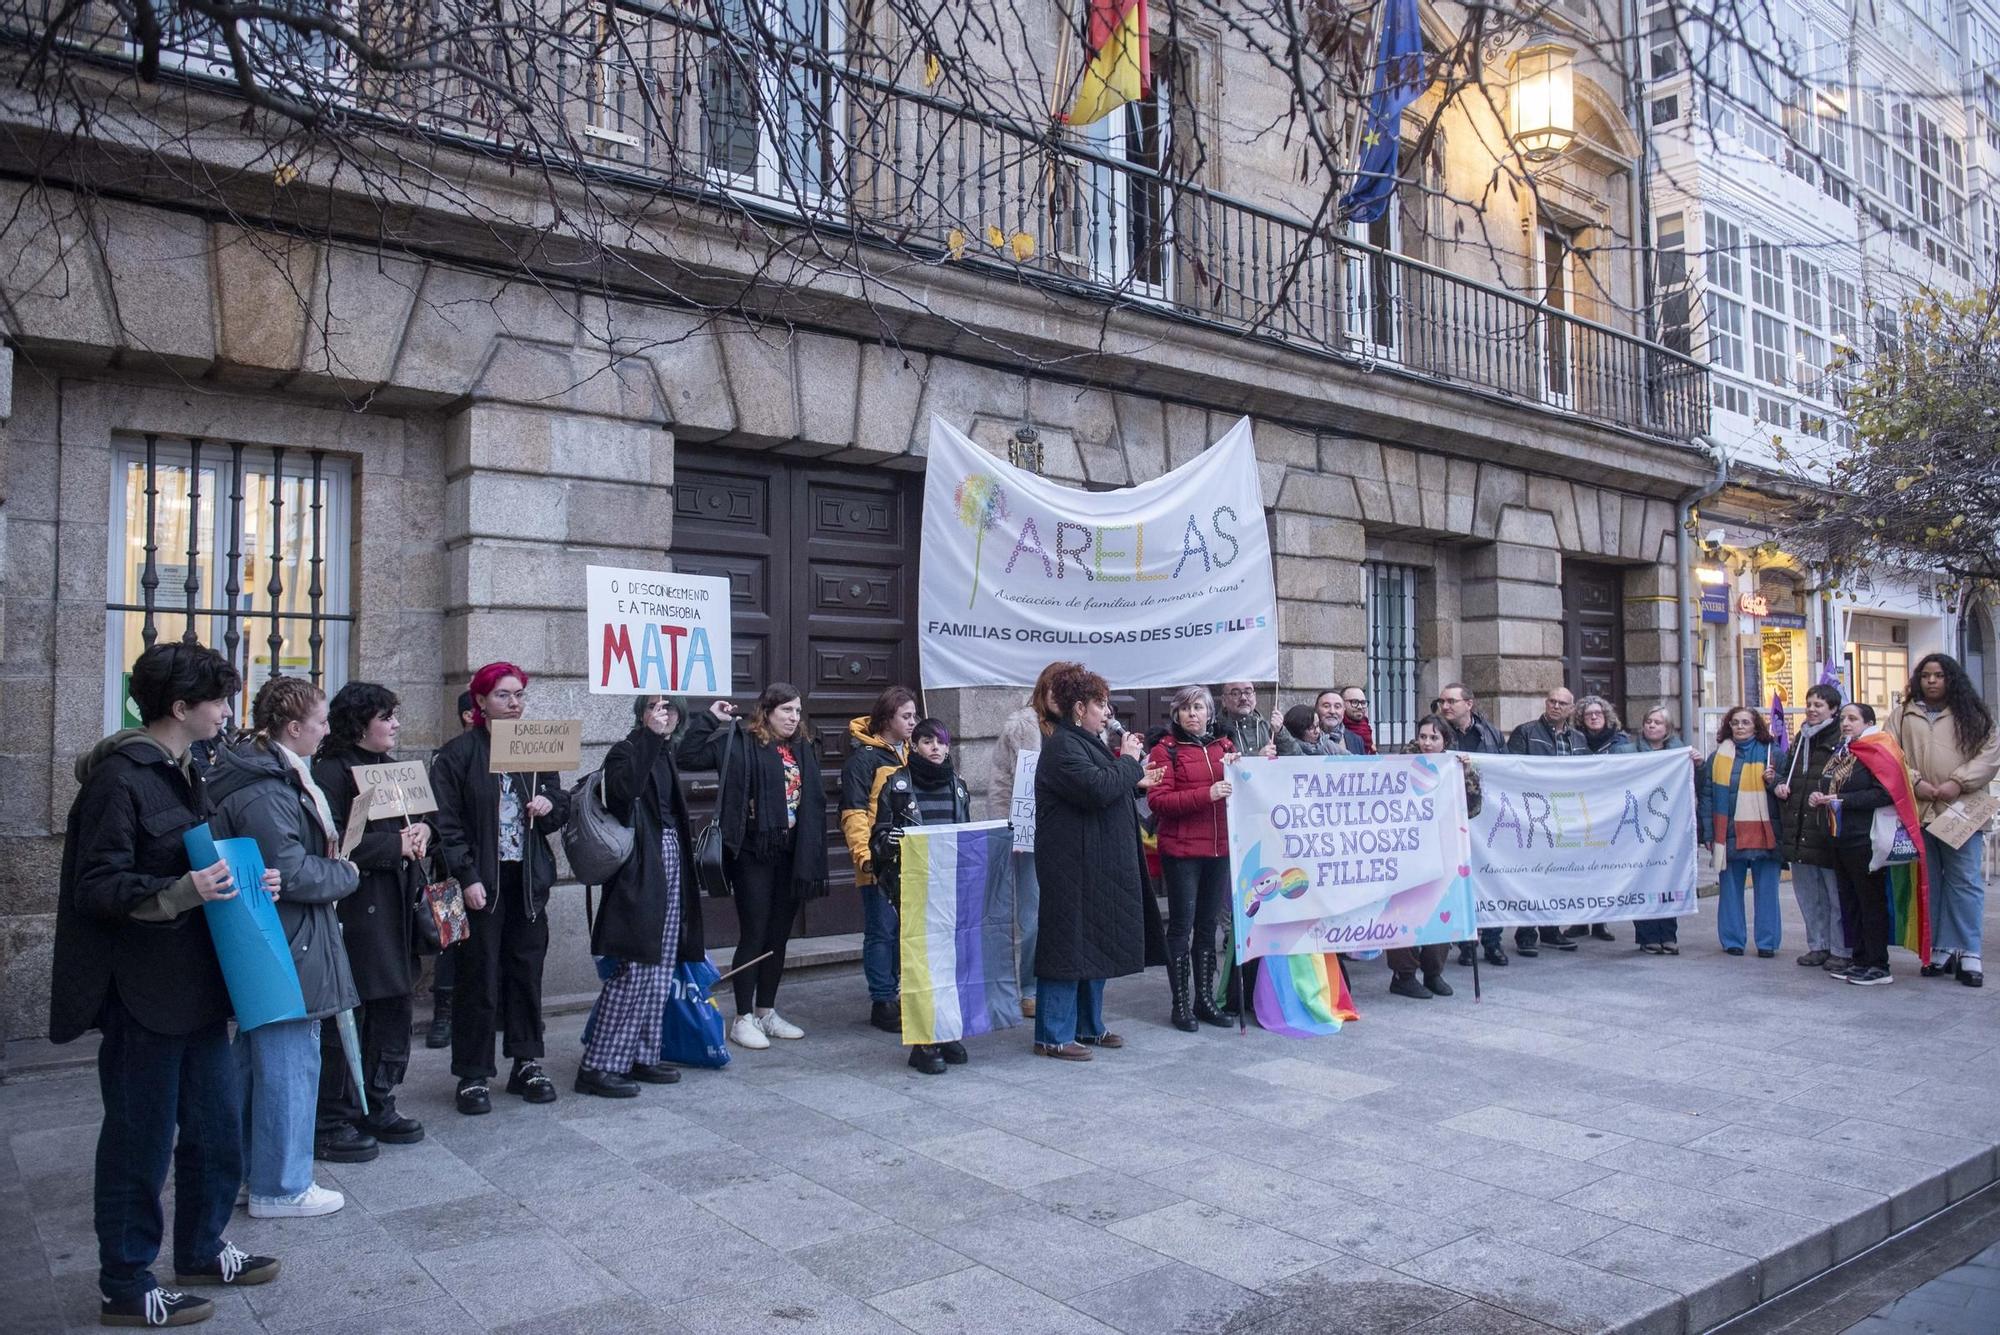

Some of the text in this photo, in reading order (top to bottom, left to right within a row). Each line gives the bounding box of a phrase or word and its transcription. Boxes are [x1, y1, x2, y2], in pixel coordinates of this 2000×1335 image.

[1005, 505, 1238, 582] ARELAS
[611, 580, 619, 593] O
[618, 600, 701, 620] E A TRANSFOBIA
[1065, 597, 1082, 609] de
[1083, 597, 1137, 611] familias
[1141, 594, 1156, 608] de
[1157, 589, 1204, 605] menores
[928, 616, 1266, 645] FAMILIAS ORGULLOSAS DES SÚES FILLES
[601, 623, 717, 692] MATA
[514, 723, 542, 737] ISABEL
[509, 739, 564, 756] REVOGACIÓN
[364, 769, 382, 785] CO
[1292, 771, 1408, 798] FAMILIAS
[1270, 798, 1434, 830] ORGULLOSAS
[1487, 786, 1671, 848] ARELAS
[1283, 826, 1420, 859] DXS NOSXS
[1316, 857, 1399, 887] FILLES
[1545, 862, 1585, 875] familias
[1497, 898, 1585, 911] ORGULLOSAS
[1587, 896, 1615, 909] DES
[1617, 892, 1646, 906] SÚES
[1325, 918, 1399, 943] arelas
